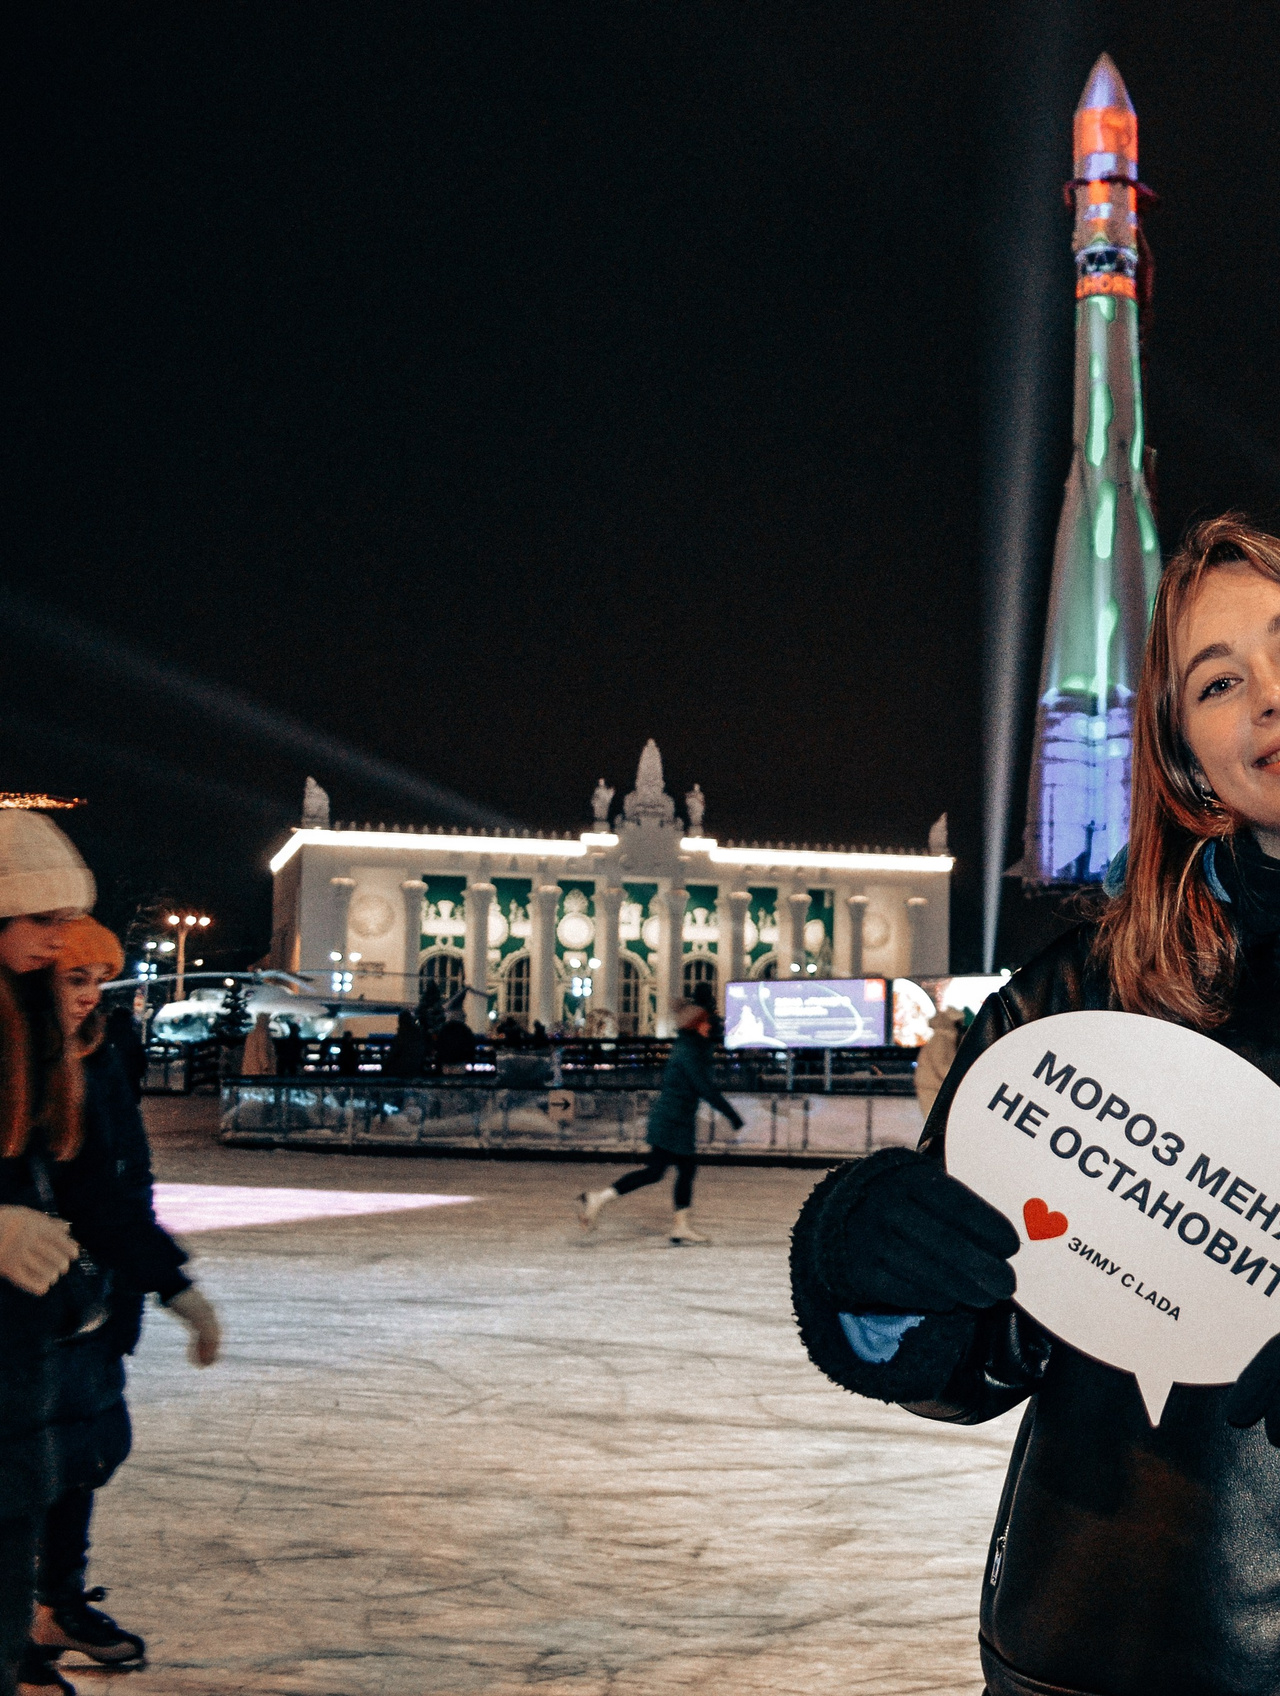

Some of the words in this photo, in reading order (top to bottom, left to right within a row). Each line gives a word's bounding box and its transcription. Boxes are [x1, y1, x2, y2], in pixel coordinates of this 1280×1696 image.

[987, 1082, 1050, 1139] НЕ
[1032, 1050, 1185, 1167] МОРОЗ
[1067, 1236, 1122, 1276] ЗИМУ
[1120, 1273, 1135, 1288] С
[1134, 1281, 1182, 1321] LADA
